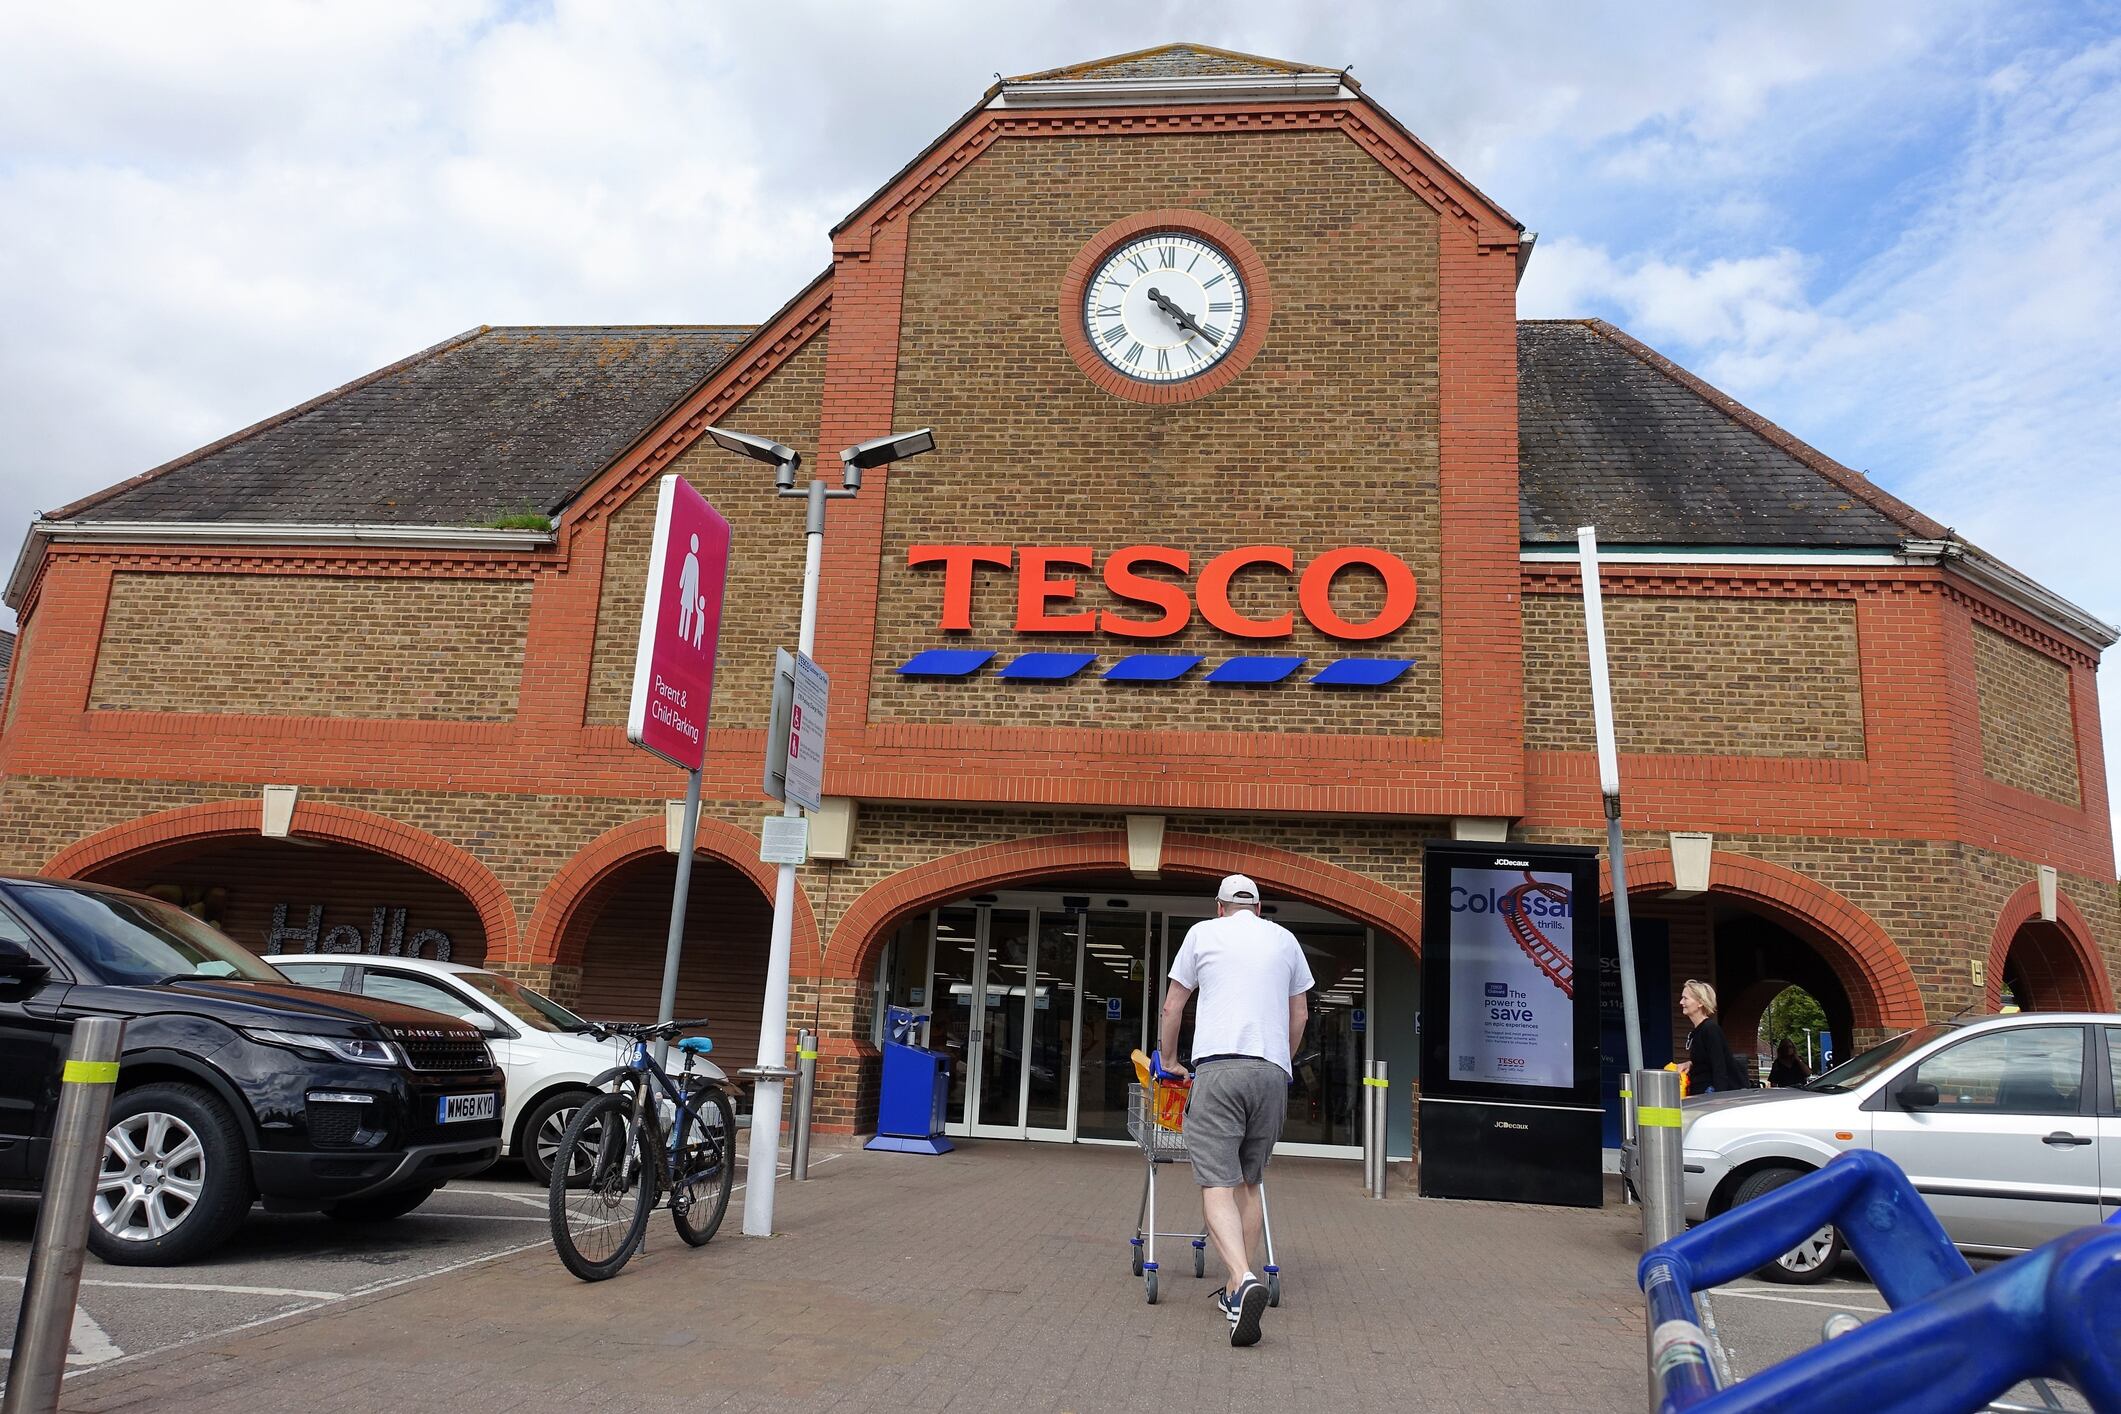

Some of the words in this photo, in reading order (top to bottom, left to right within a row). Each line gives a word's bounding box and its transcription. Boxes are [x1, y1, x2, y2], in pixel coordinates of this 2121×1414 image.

[908, 546, 1417, 640] TESCO
[655, 674, 681, 705] Parent
[680, 690, 687, 709] &
[652, 700, 672, 726] Child
[672, 710, 699, 745] Parking
[1494, 858, 1530, 867] JCDecaux
[1451, 886, 1573, 918] Colossal
[1537, 920, 1565, 930] thrills.
[268, 903, 451, 962] Hello
[1510, 990, 1527, 999] The
[1484, 999, 1514, 1008] power
[1517, 1000, 1527, 1008] to
[1490, 1008, 1533, 1022] save
[393, 1029, 444, 1038] RANGE
[448, 1030, 480, 1038] ROVER
[1497, 1057, 1525, 1065] TESCO
[447, 1097, 476, 1119] WM68
[476, 1096, 493, 1116] KYO
[1494, 1121, 1529, 1130] JCDecaux
